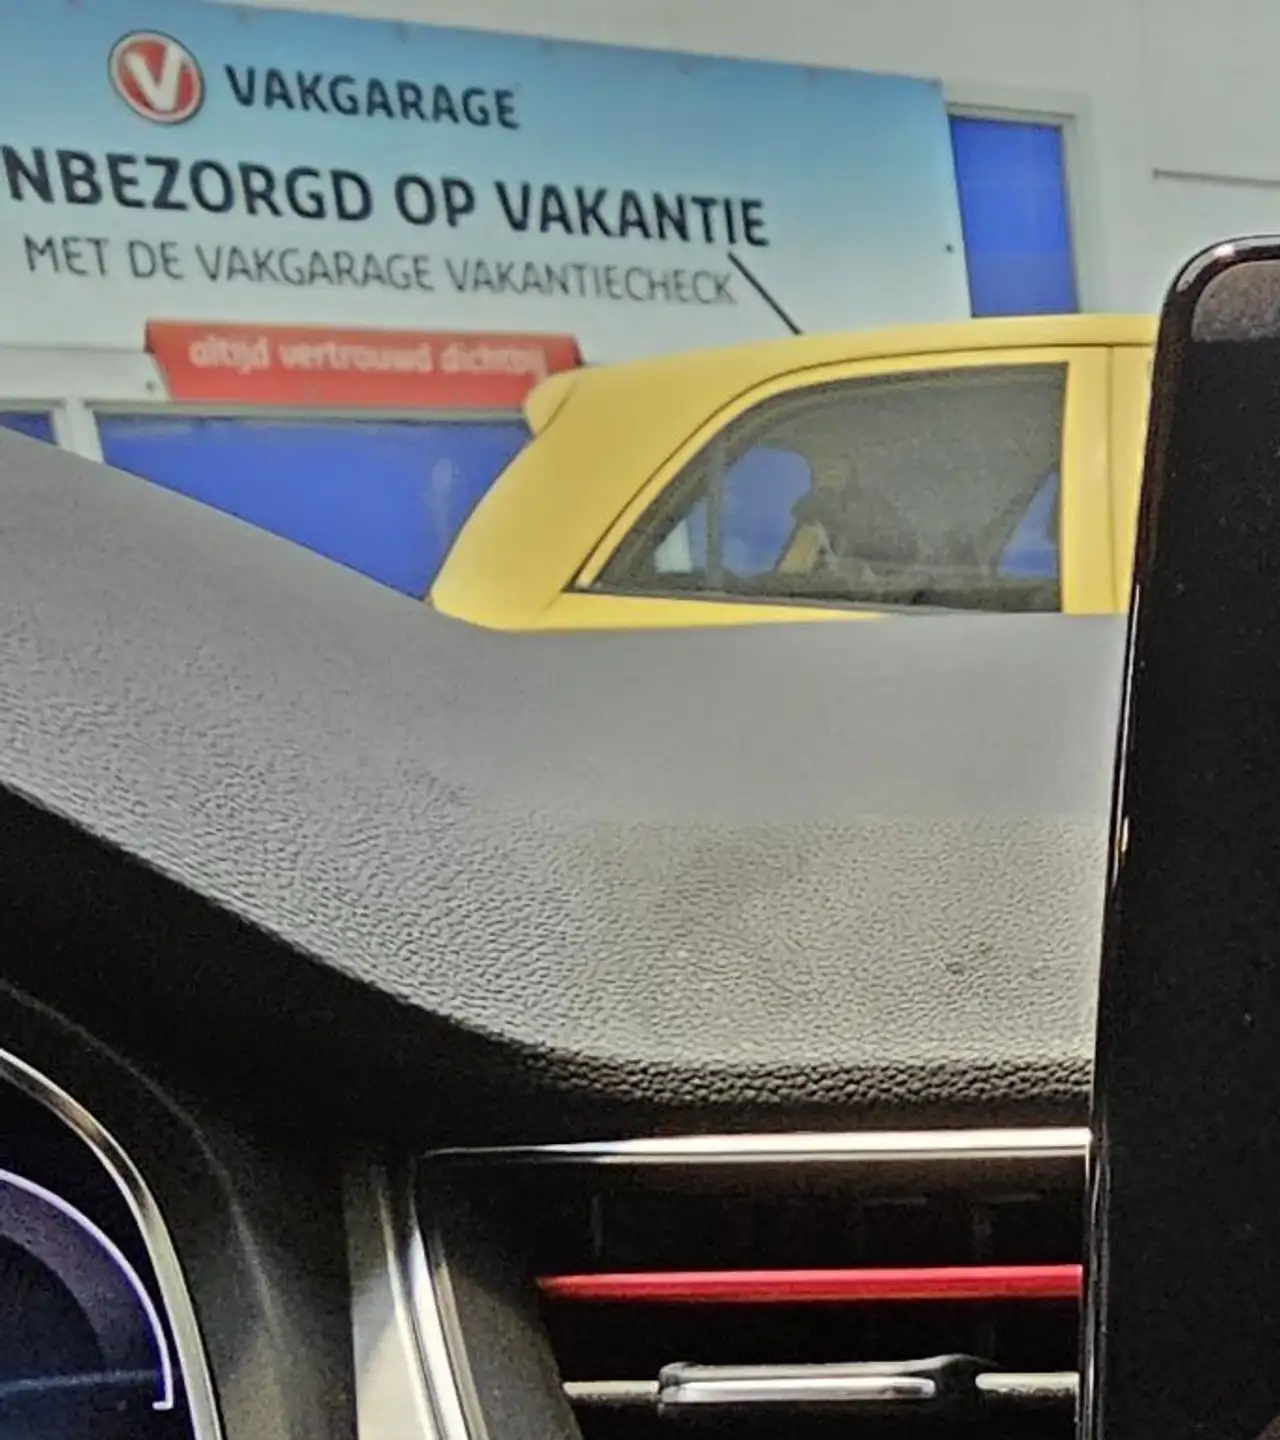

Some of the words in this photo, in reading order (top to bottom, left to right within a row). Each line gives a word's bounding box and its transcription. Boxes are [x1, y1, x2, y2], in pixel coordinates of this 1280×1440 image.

[224, 63, 520, 131] VAKGARAGE
[1, 144, 374, 222] NBEZORGD
[395, 172, 476, 229] OP
[494, 179, 770, 248] VAKANTIE
[24, 232, 109, 277] MET
[128, 240, 184, 281] DE
[195, 243, 434, 291] VAKGARAGE
[445, 257, 738, 304] VAKANTIECHECK
